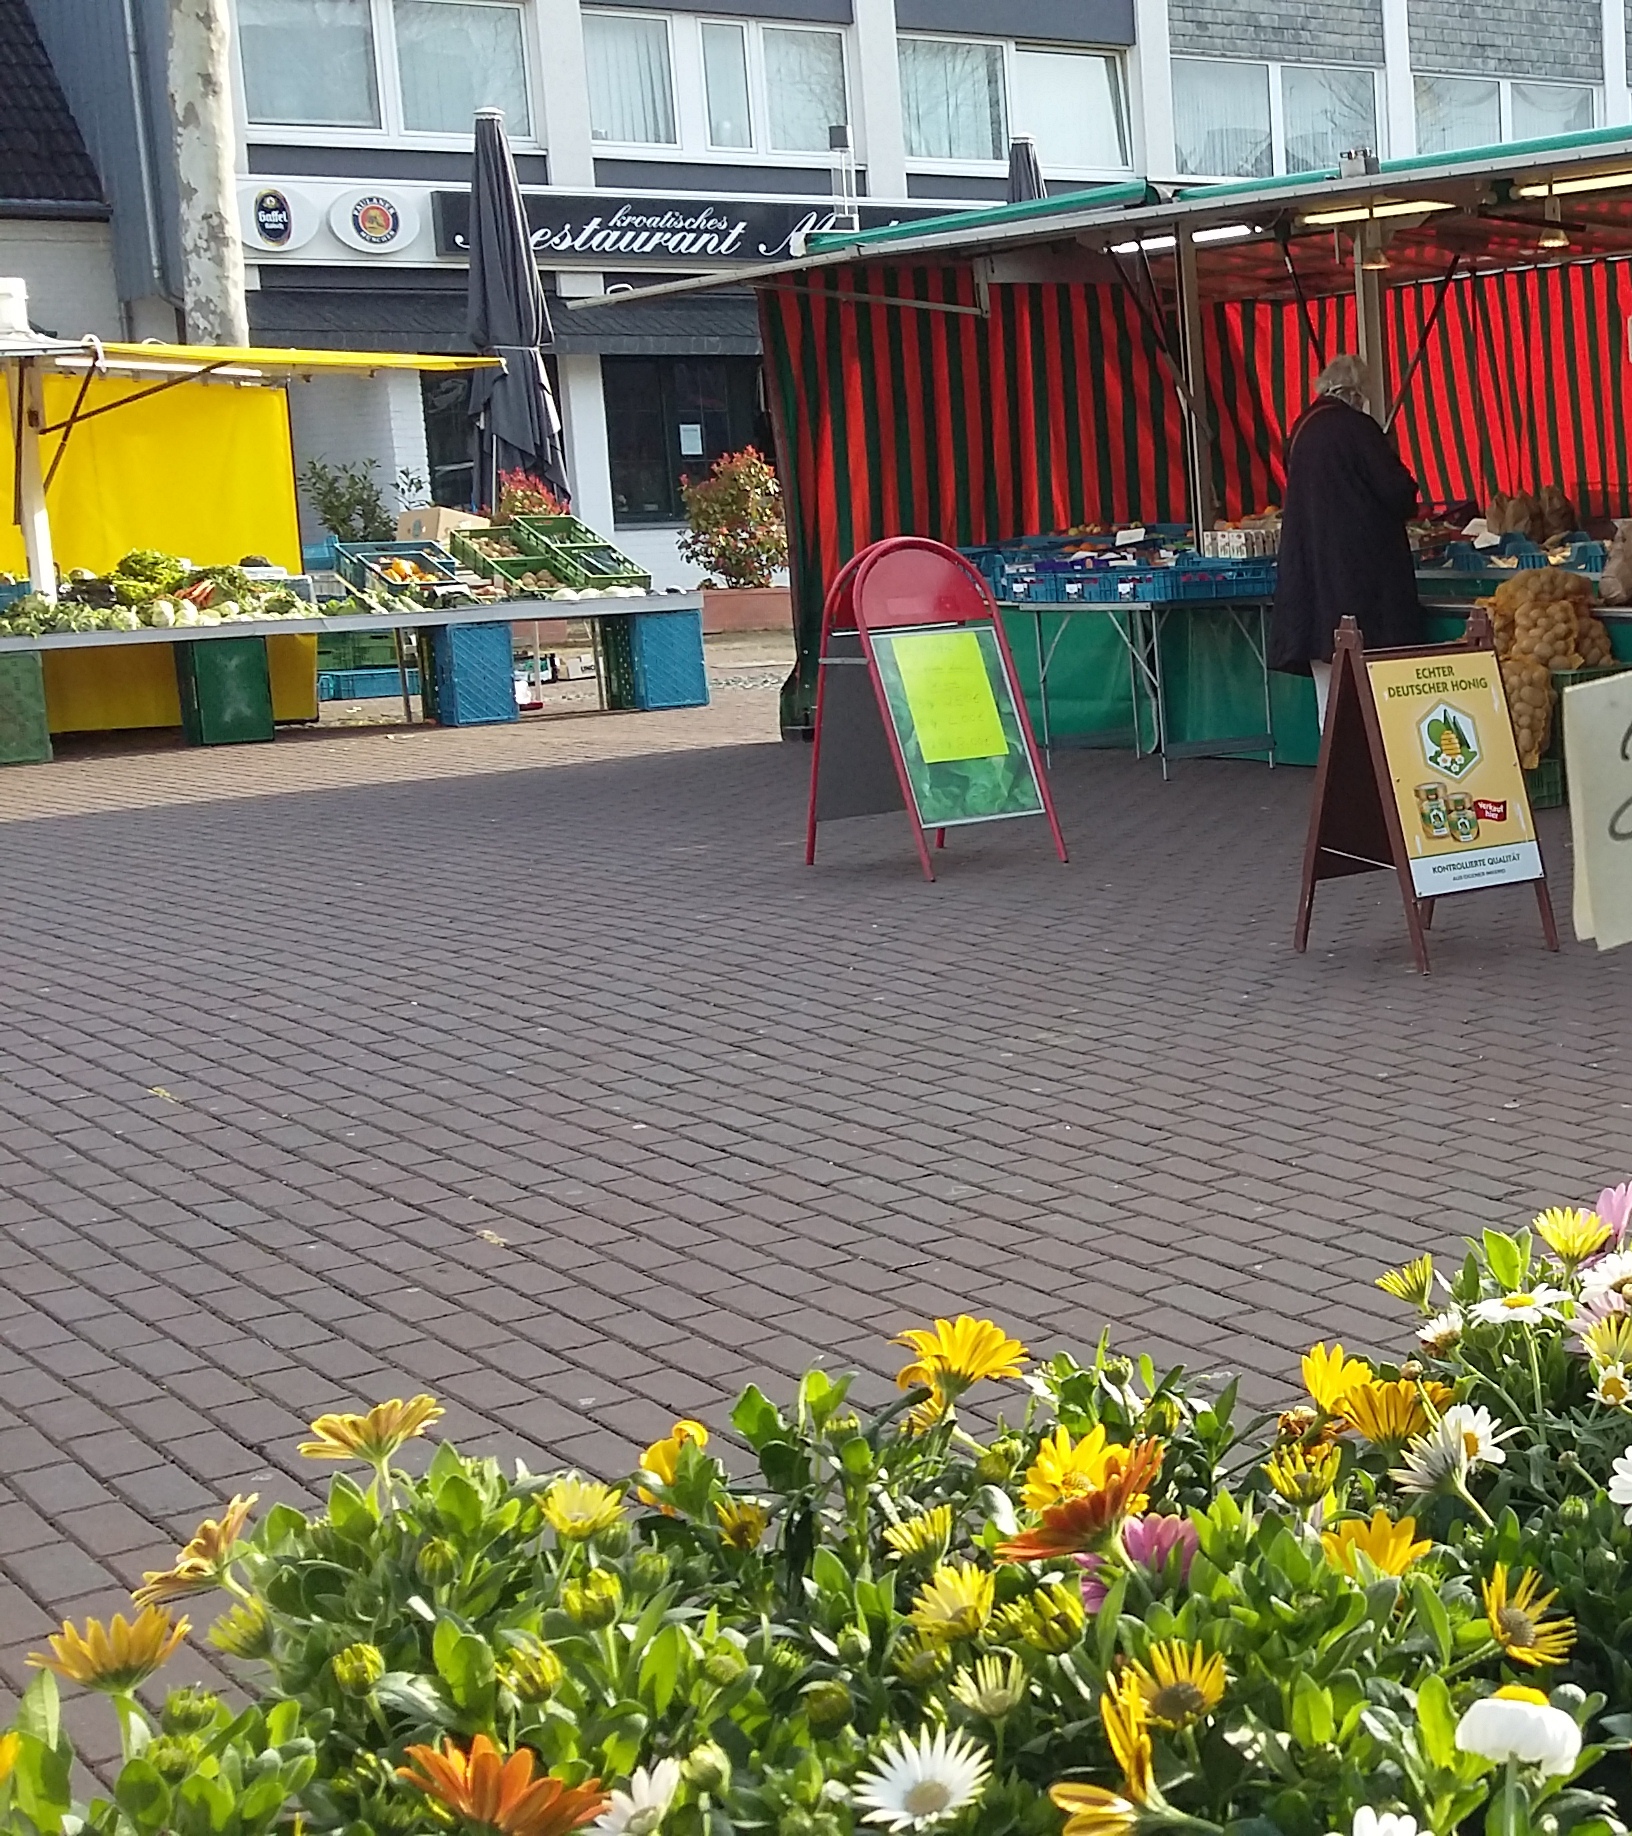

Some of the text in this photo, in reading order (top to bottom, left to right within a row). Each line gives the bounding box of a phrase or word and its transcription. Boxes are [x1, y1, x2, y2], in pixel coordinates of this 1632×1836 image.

[258, 210, 289, 223] Gaffel
[353, 196, 397, 216] PAULANER
[608, 203, 728, 230] kroatisches
[455, 215, 748, 256] estaurant
[1415, 665, 1455, 680] ECHTER
[1387, 677, 1488, 698] DEUTSCHER HONIG
[1432, 851, 1521, 874] KONTROLLIERTE QUALITÄT
